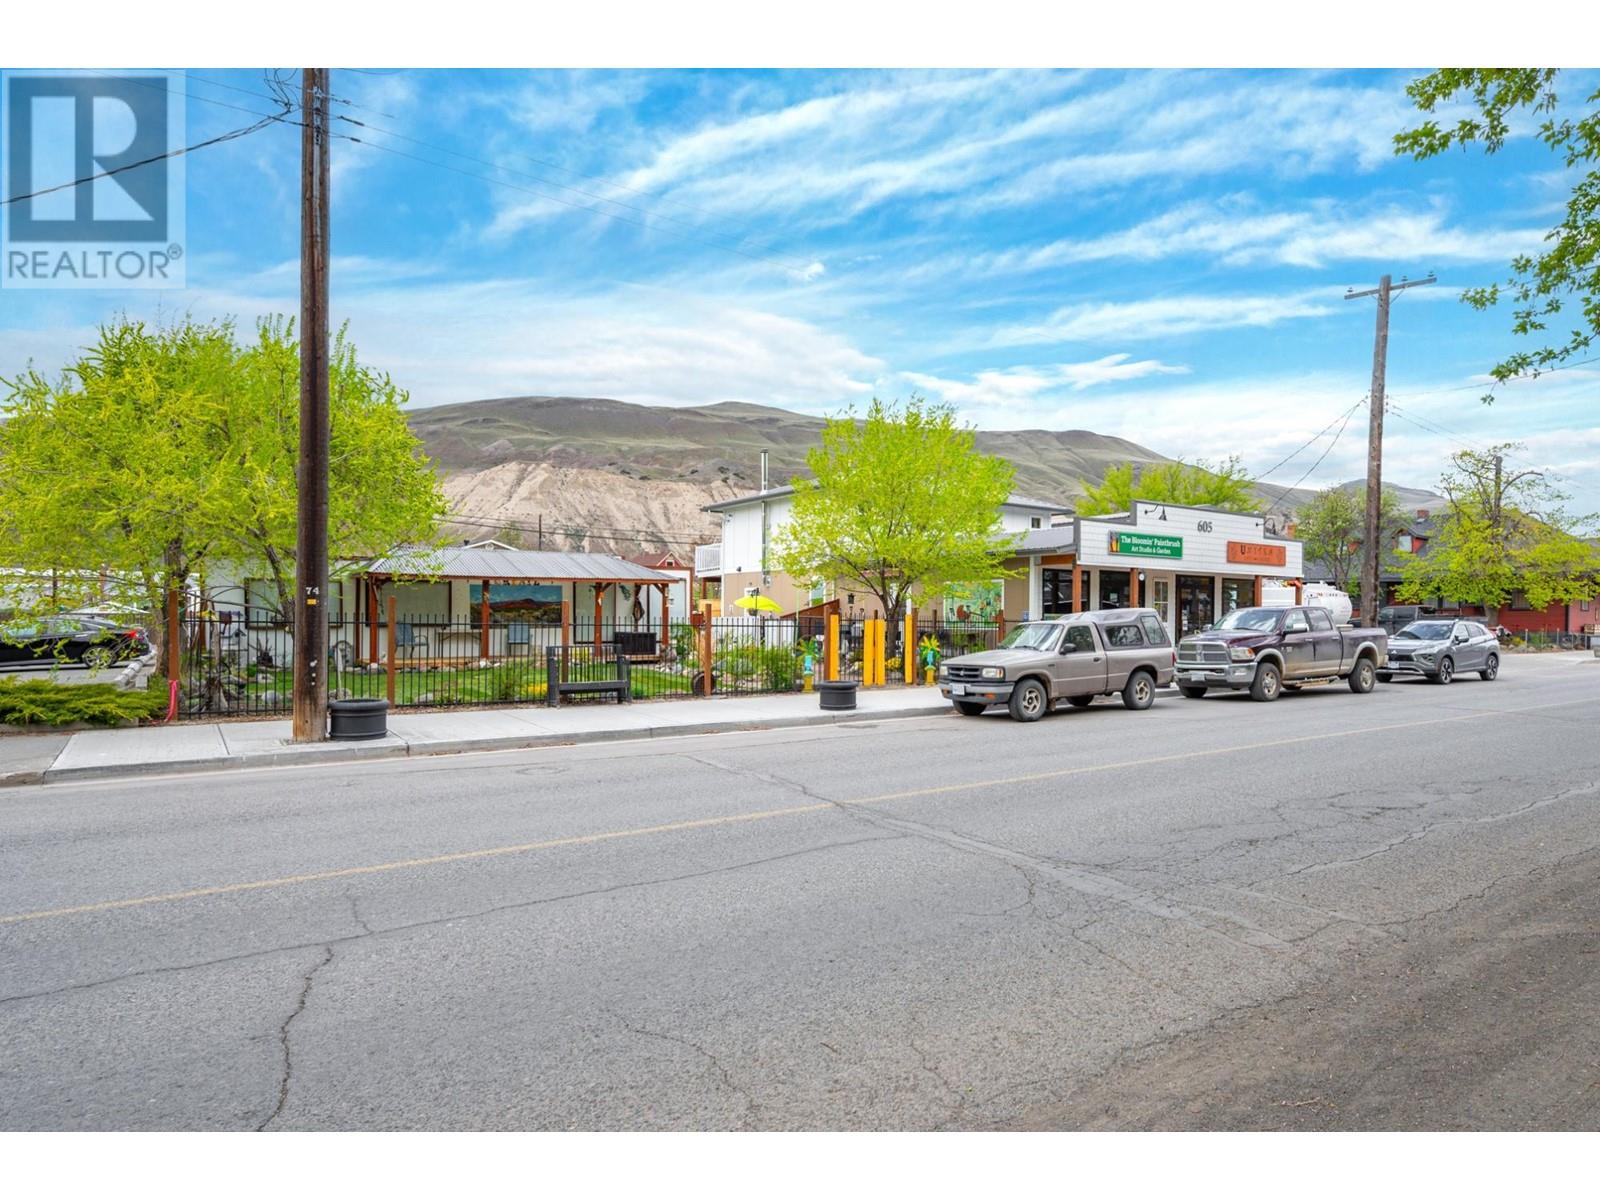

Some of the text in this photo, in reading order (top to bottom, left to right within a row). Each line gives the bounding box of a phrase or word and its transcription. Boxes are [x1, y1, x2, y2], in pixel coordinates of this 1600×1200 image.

[1197, 520, 1213, 533] 605
[1121, 535, 1132, 544] The
[1154, 538, 1181, 548] Paintbrush
[305, 586, 319, 595] 74
